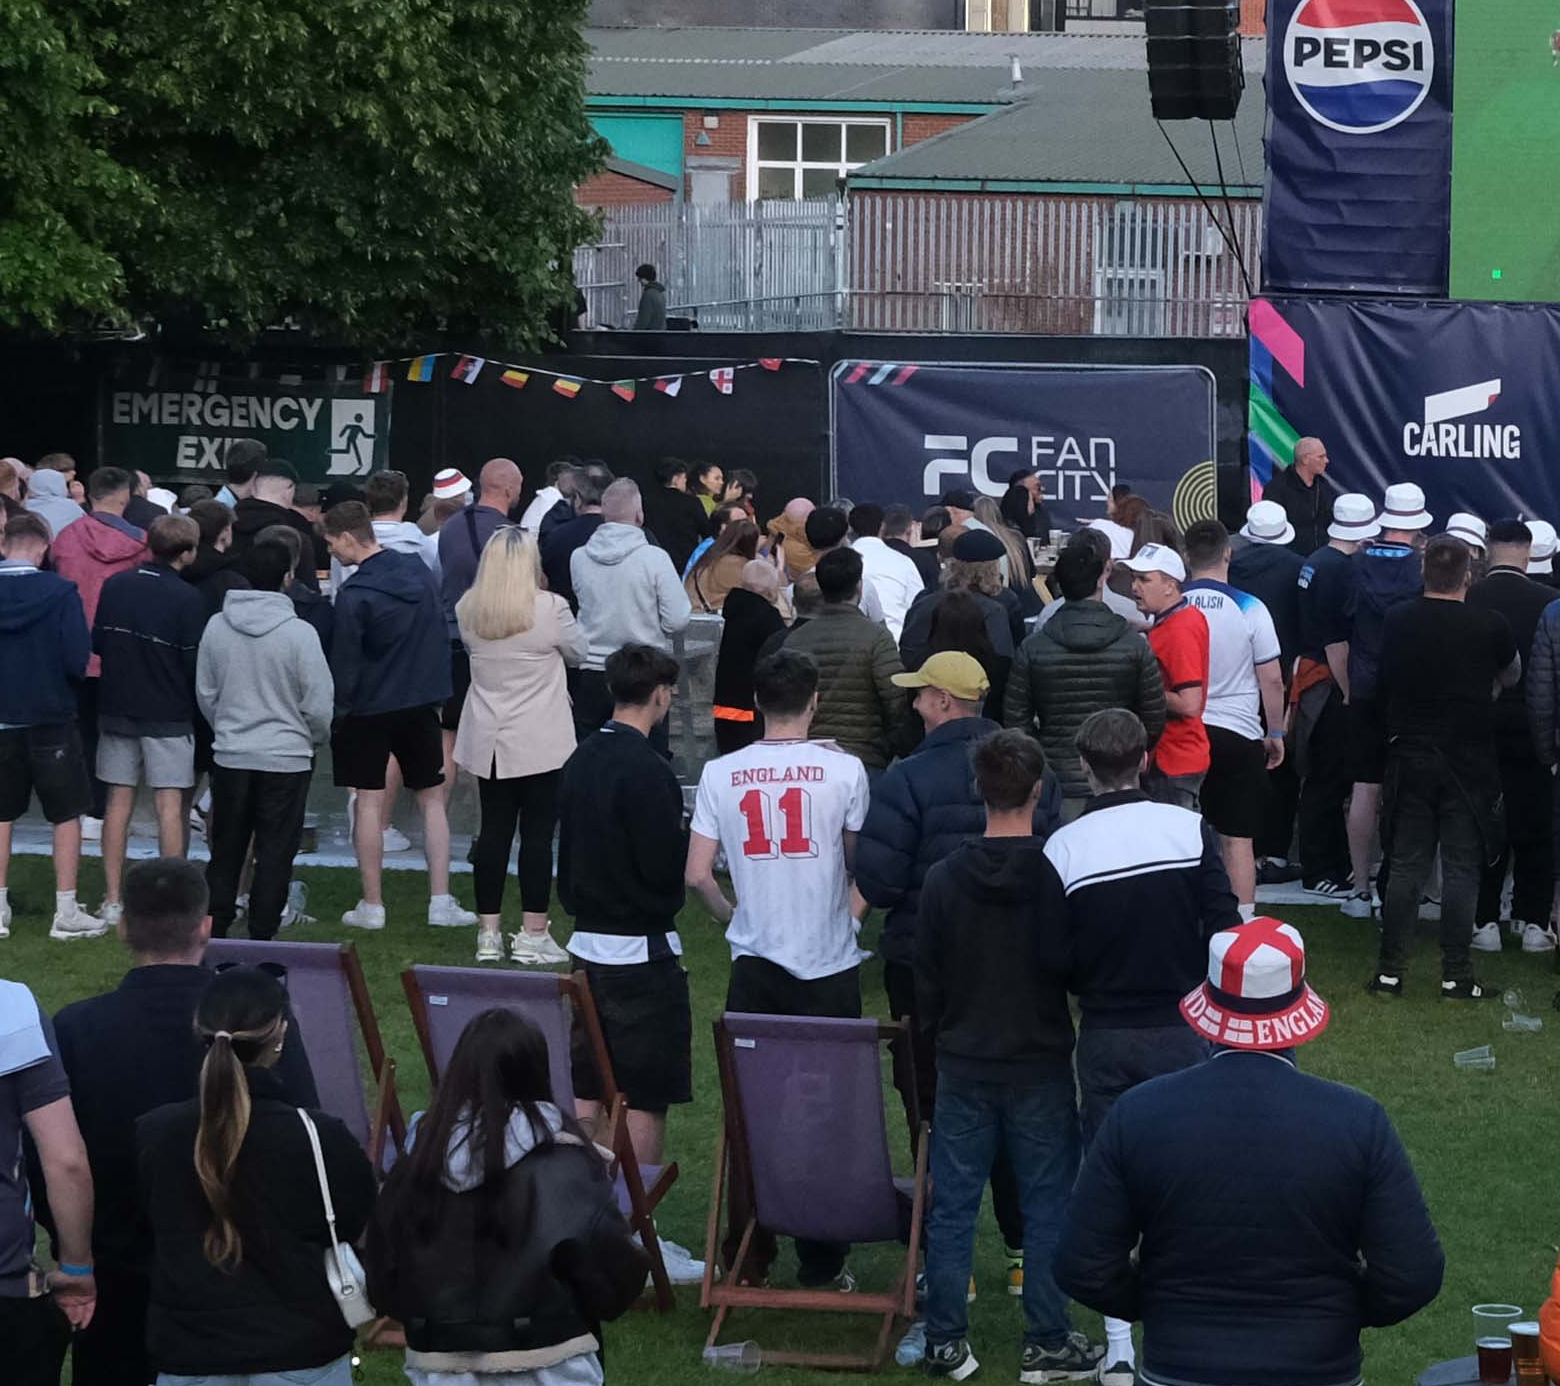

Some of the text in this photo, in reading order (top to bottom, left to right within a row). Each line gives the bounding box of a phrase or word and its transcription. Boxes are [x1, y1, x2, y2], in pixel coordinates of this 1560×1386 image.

[1293, 36, 1424, 72] PEPSI
[112, 392, 323, 431] EMERGENCY
[176, 435, 245, 470] EXI
[1031, 436, 1116, 468] FAN
[1403, 421, 1521, 459] CARLING
[923, 434, 1019, 498] FC
[731, 765, 825, 787] ENGLAND
[738, 787, 820, 861] 11
